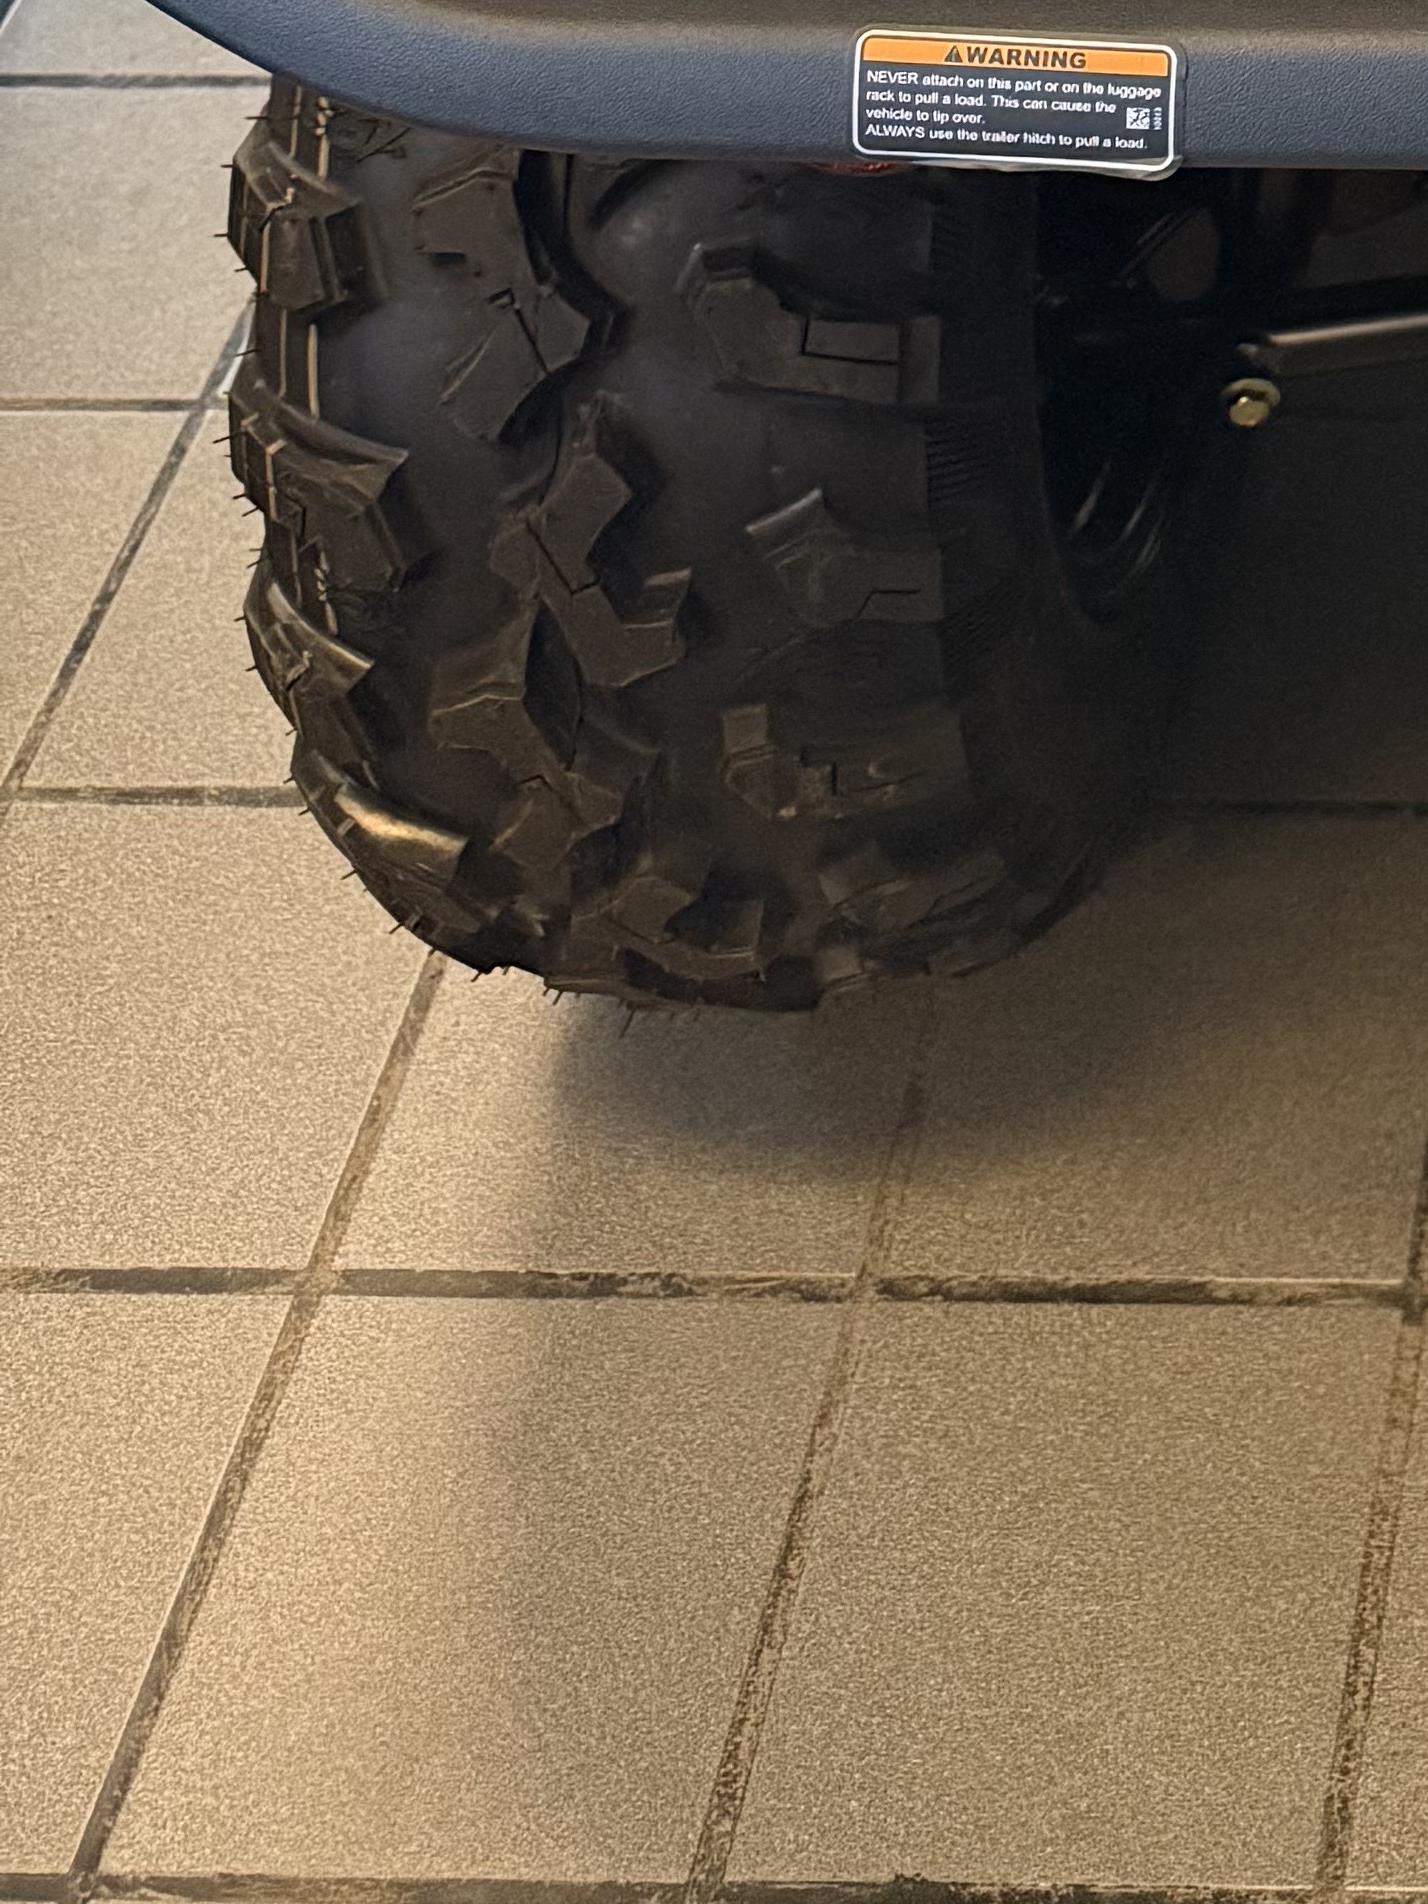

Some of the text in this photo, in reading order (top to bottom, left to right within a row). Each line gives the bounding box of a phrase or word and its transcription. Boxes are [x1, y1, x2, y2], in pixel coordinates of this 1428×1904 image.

[966, 46, 1087, 69] WARNING
[867, 70, 1162, 100] NEVER attach on this part or on the luggage
[866, 90, 1117, 114] rack to pull a load. This can cause the
[865, 108, 986, 124] vehicle to tip over.
[865, 123, 1148, 149] ALWAYS use the trailer hitch to pull a load.
